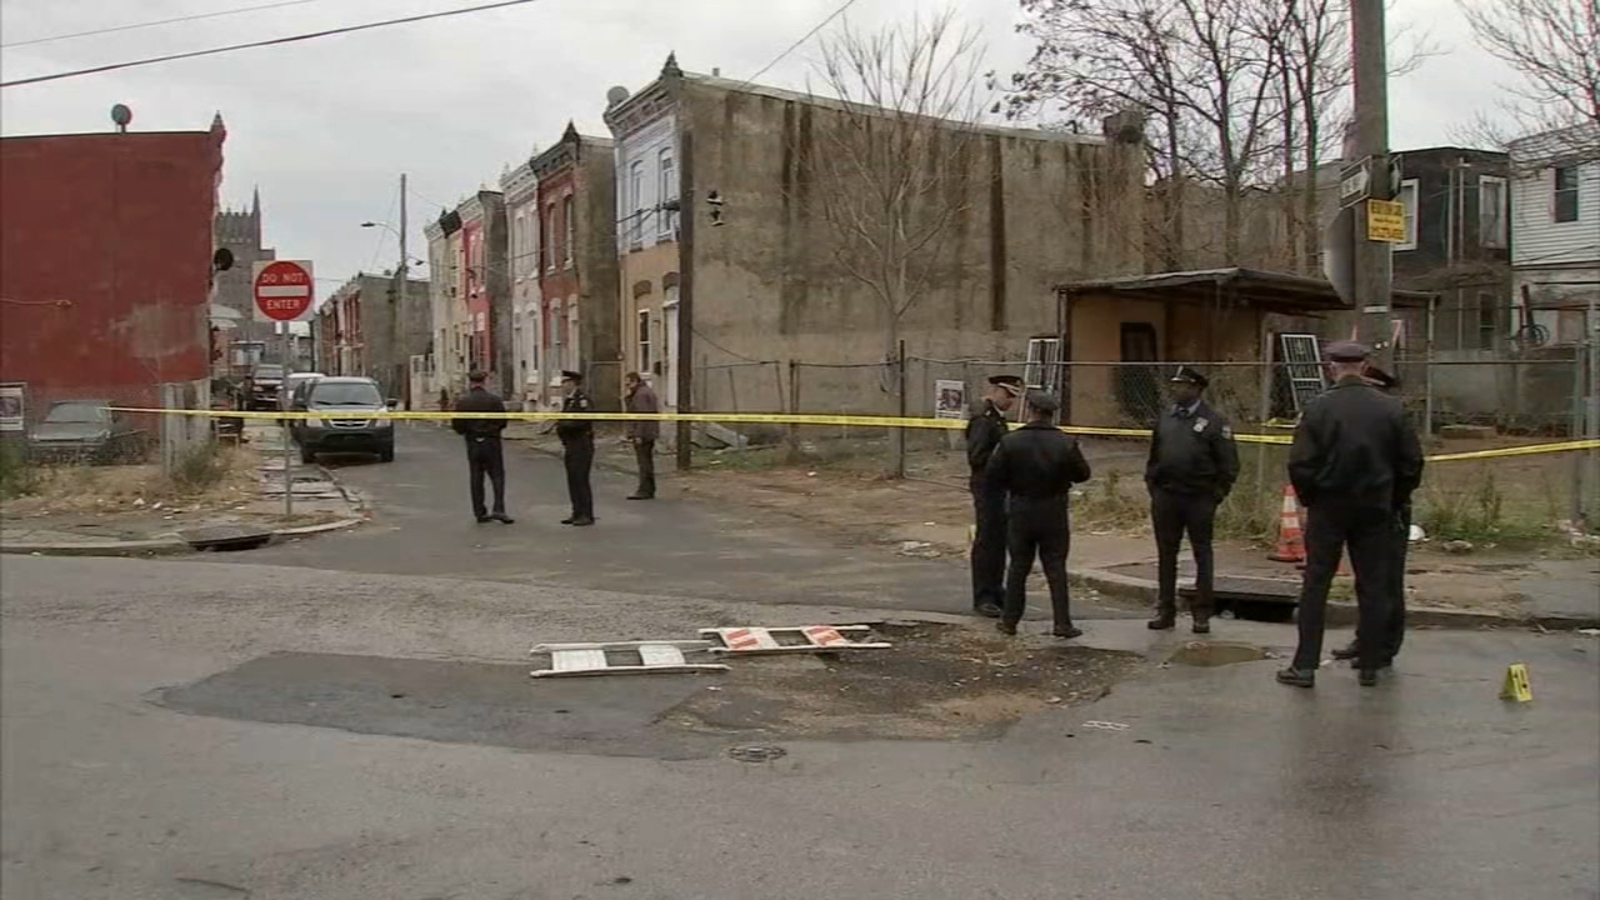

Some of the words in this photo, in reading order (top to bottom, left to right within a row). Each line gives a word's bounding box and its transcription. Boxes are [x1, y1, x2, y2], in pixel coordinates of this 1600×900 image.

[262, 273, 277, 283] DO
[282, 272, 304, 283] NOT
[266, 299, 300, 310] ENTER
